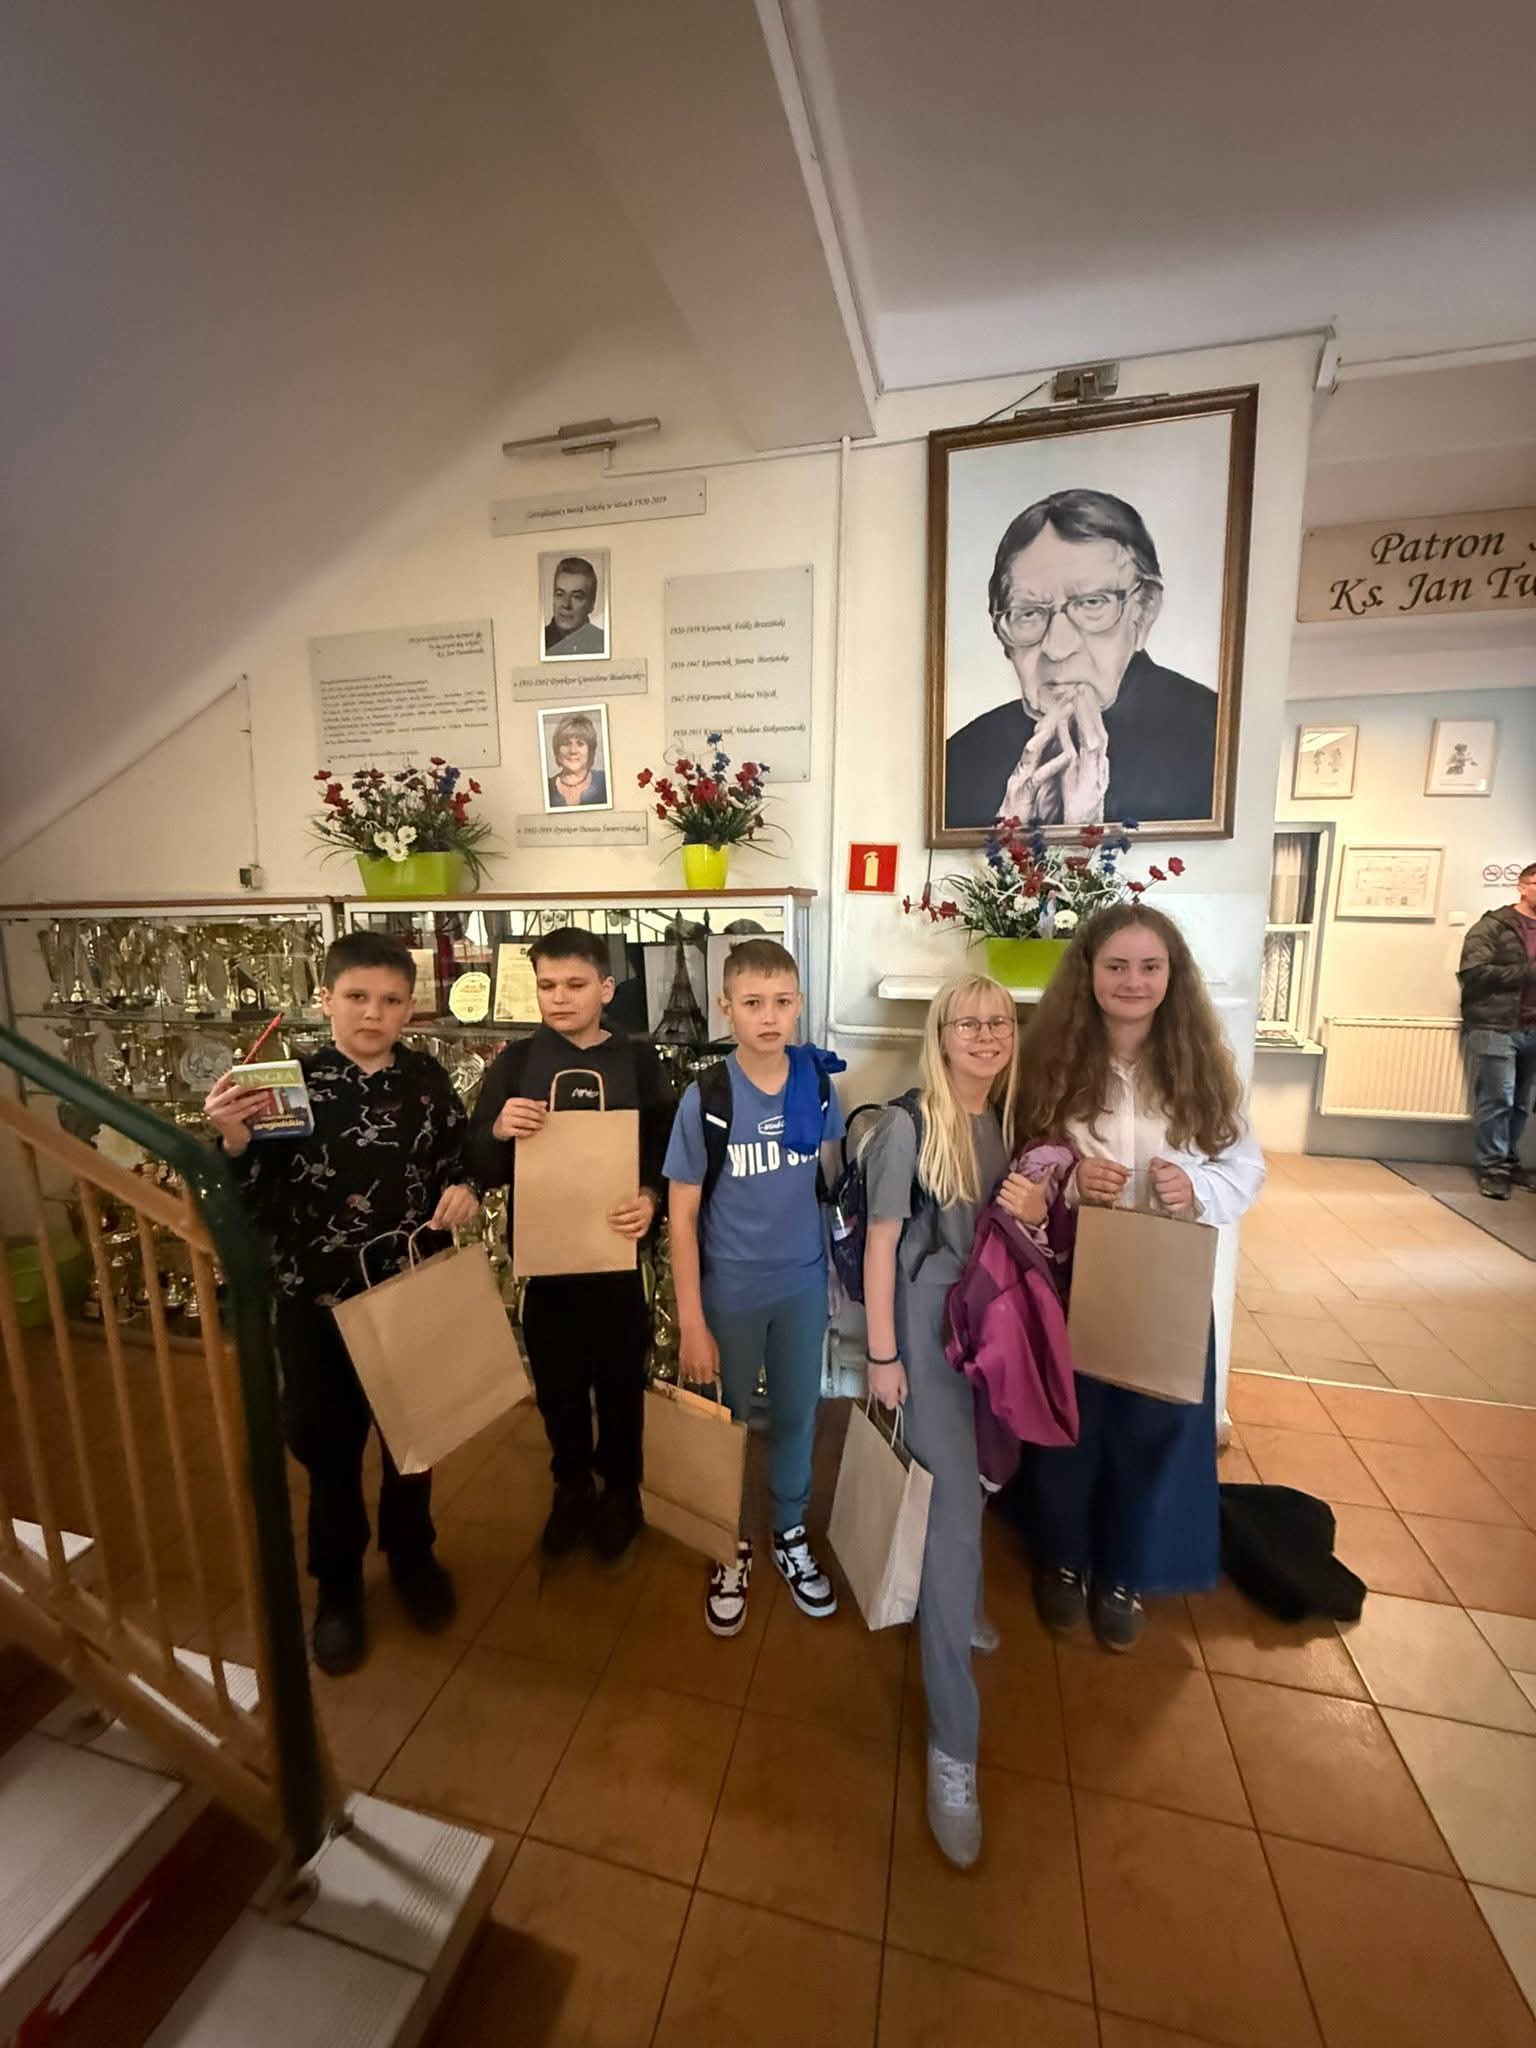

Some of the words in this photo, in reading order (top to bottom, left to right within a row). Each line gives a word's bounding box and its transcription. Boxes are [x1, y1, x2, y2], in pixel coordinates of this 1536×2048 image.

[1371, 529, 1505, 565] Patron
[1330, 577, 1384, 616] Ks.
[1398, 572, 1474, 611] Jan
[727, 1140, 781, 1177] WILD
